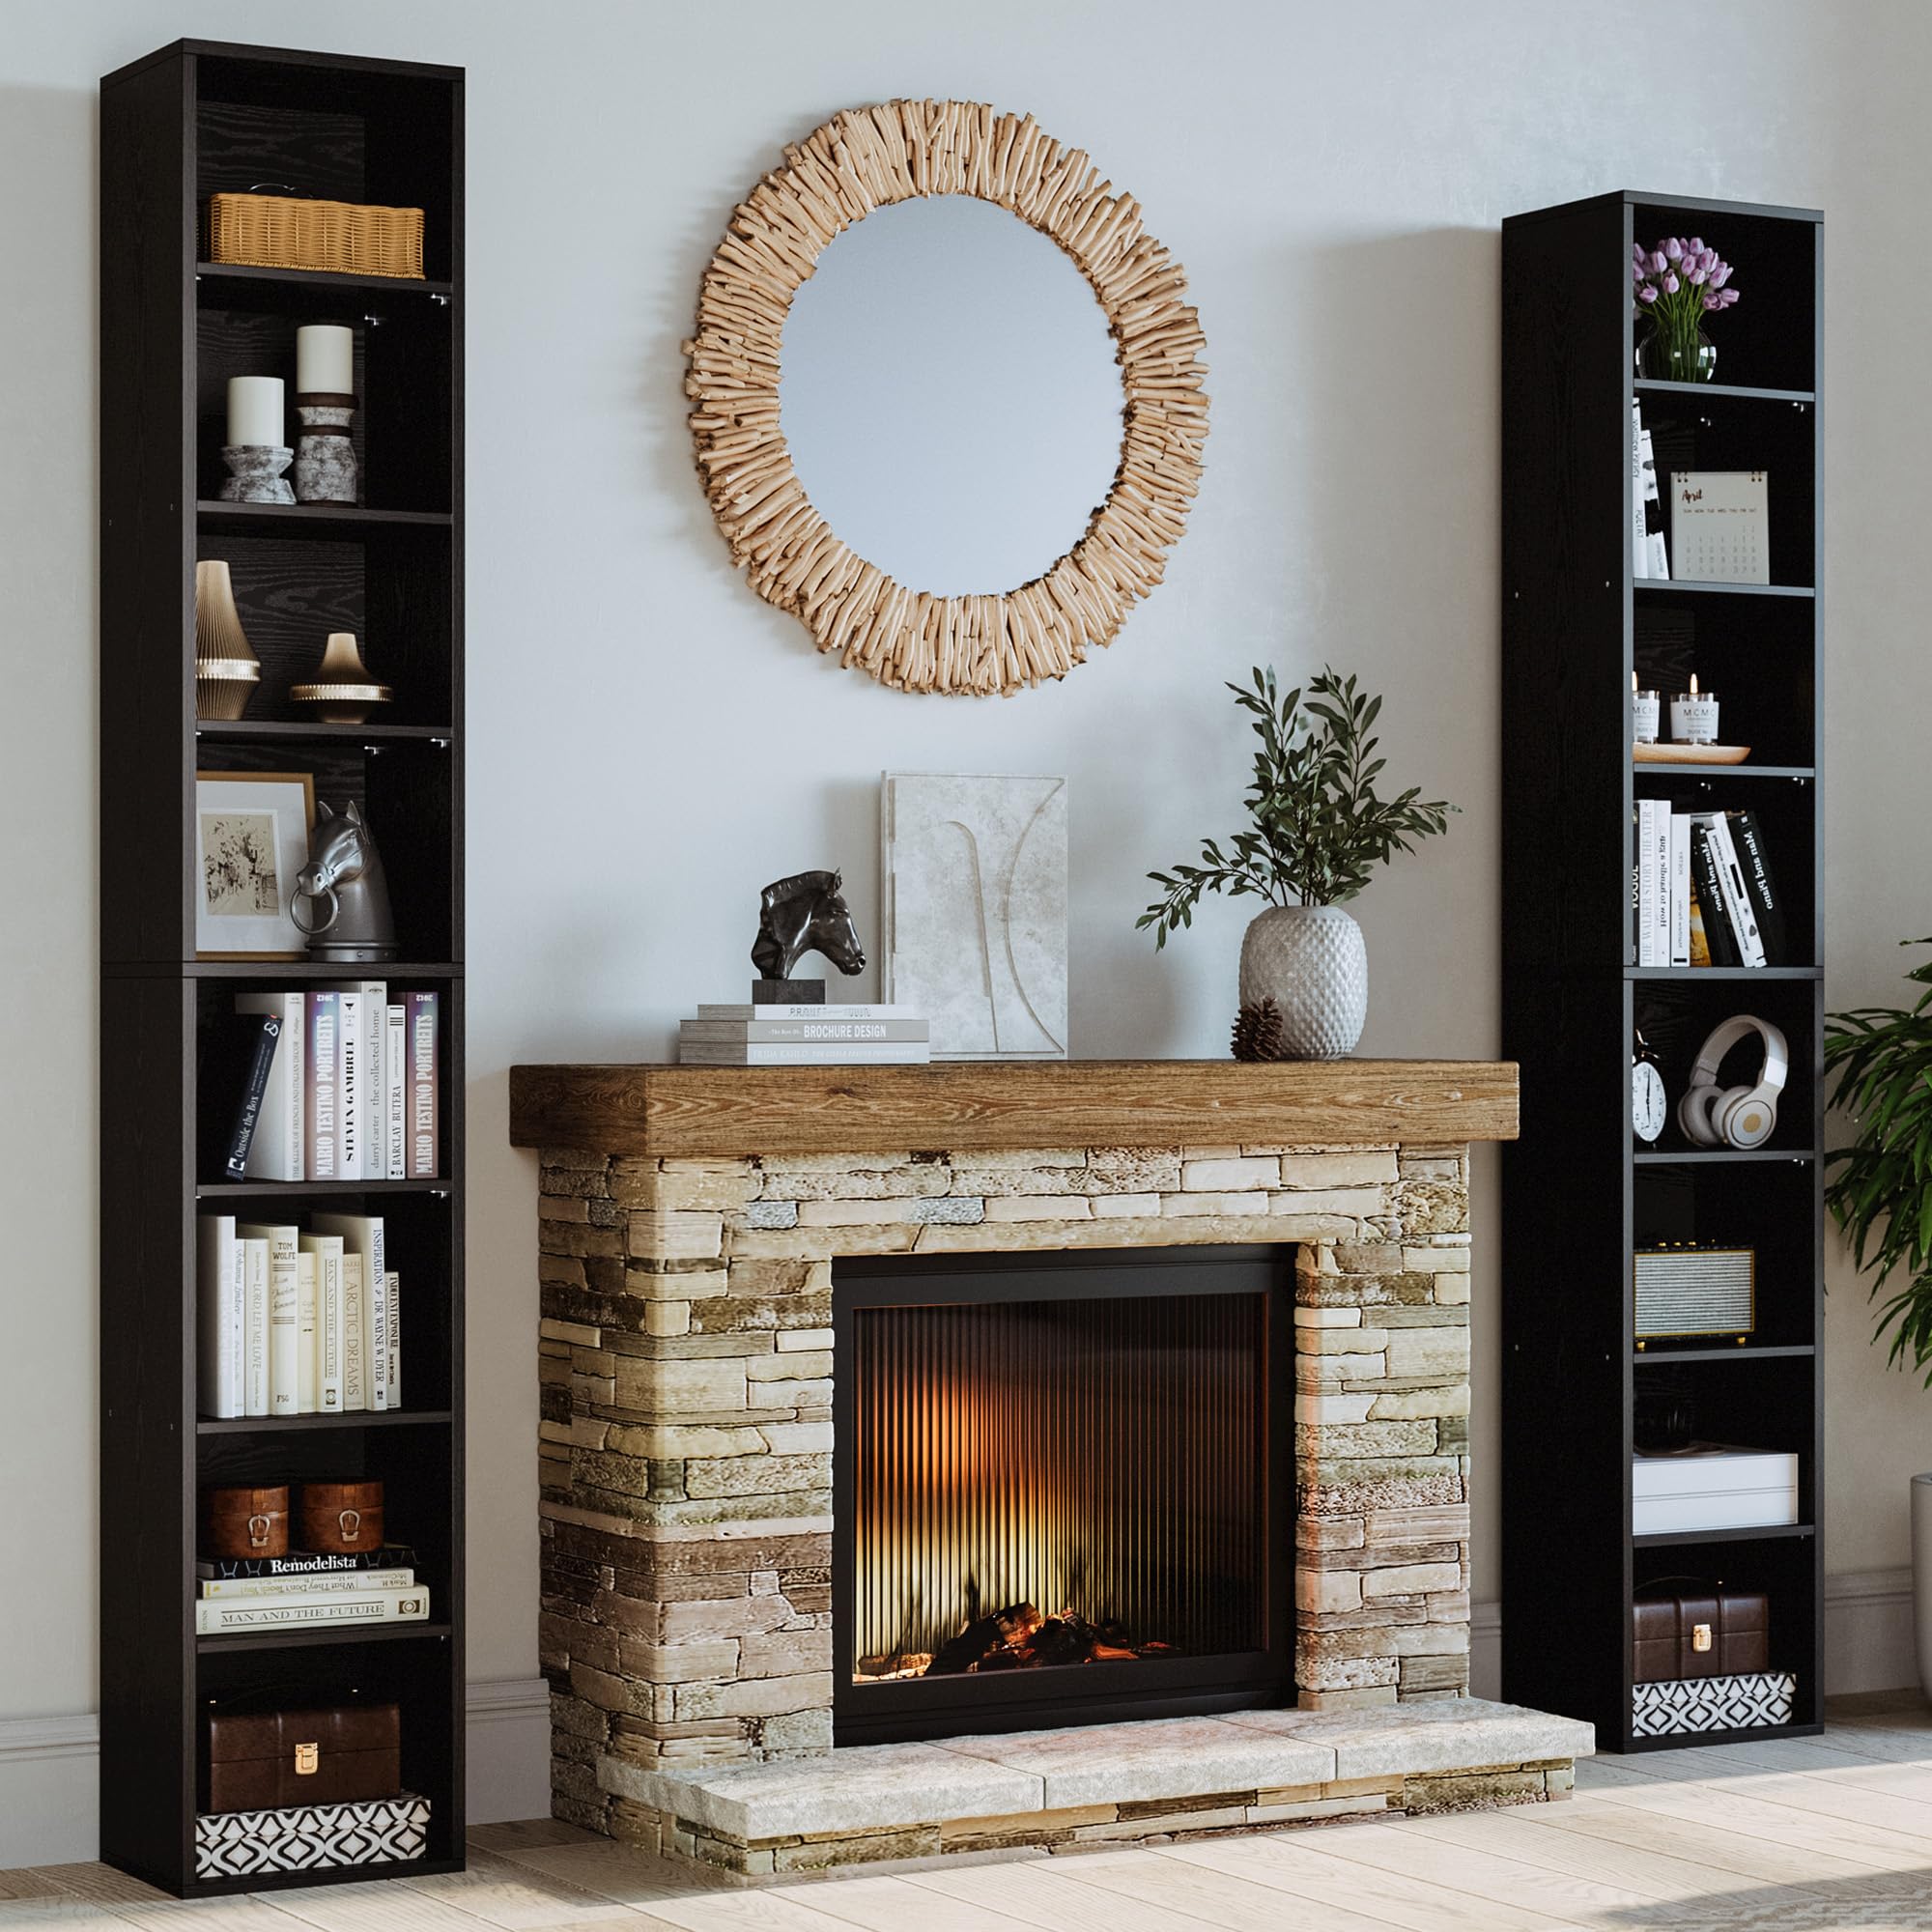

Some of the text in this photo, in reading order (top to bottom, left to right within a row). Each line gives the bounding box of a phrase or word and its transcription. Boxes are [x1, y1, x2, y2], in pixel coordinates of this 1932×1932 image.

[1682, 489, 1702, 503] April
[1642, 811, 1652, 962] THE WALKER STORY THEATER
[804, 1025, 886, 1038] BROCHURE DESIGN
[345, 1038, 354, 1105] GAMBREL
[369, 1009, 382, 1168] darryl carter the collected home
[234, 1095, 260, 1158] Outside the Box
[316, 1085, 334, 1133] TESTINO
[392, 1086, 401, 1165] BARCLAY BUTERA
[416, 1084, 433, 1132] TESTINO
[345, 1109, 354, 1162] STEVEN
[416, 1135, 433, 1174] MARIO
[316, 1137, 334, 1176] MARIO
[278, 1242, 293, 1250] TOM
[373, 1229, 383, 1285] INSPIRATION
[347, 1281, 358, 1333] ARCTIC
[375, 1318, 384, 1346] WAYNE
[348, 1339, 359, 1396] DREAMS
[375, 1359, 384, 1382] DYER
[271, 1556, 357, 1573] Remodelista
[286, 1584, 307, 1593] Don't
[309, 1581, 328, 1591] They
[331, 1582, 355, 1590] What
[221, 1604, 384, 1624] MAN AND THE FUTURE
